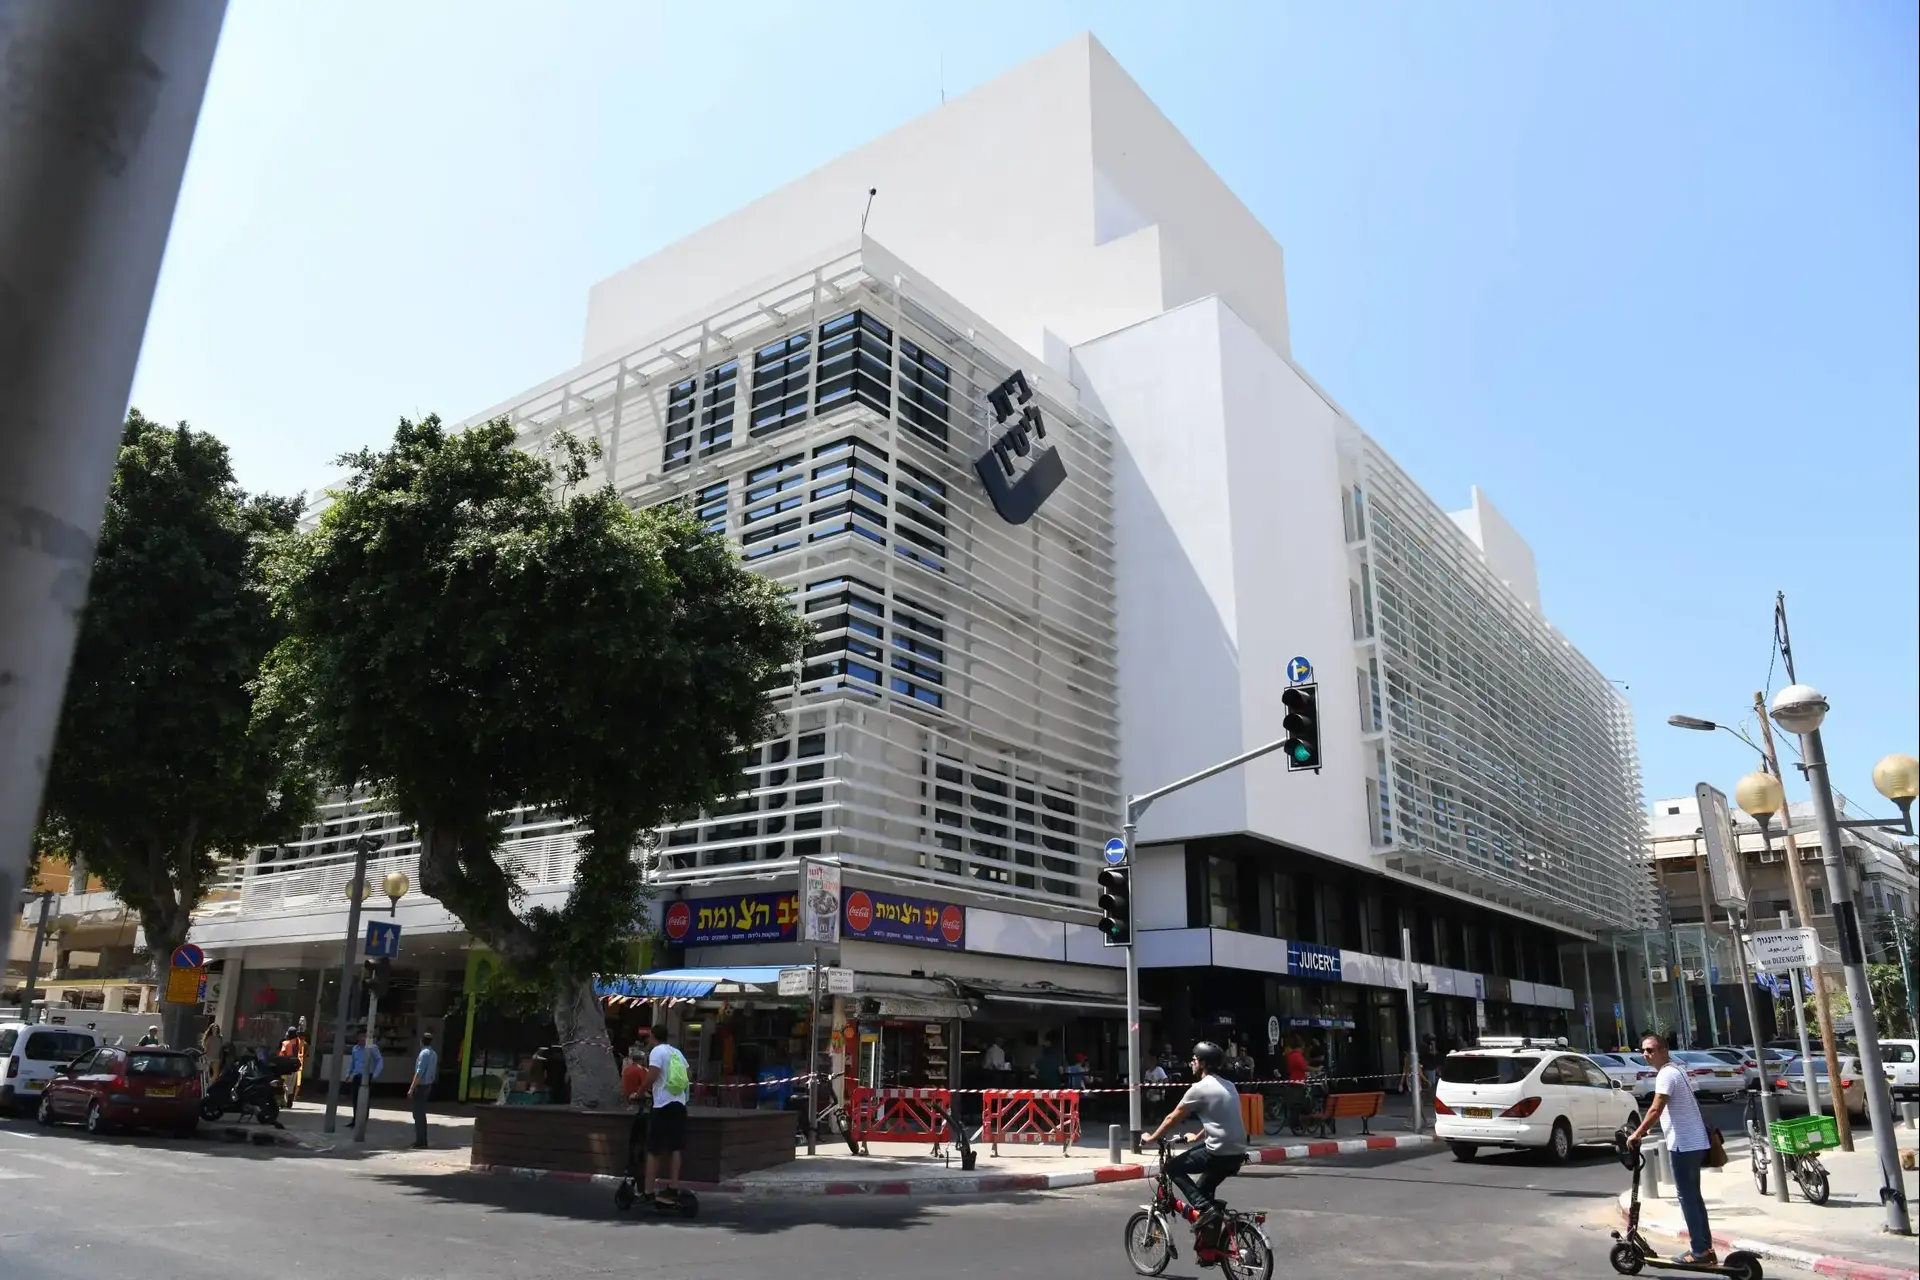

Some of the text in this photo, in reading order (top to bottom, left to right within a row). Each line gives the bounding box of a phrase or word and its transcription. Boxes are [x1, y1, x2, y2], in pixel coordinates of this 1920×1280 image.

[697, 898, 770, 930] הצומת
[875, 902, 939, 925] לב הצומת
[1756, 935, 1782, 946] דיזנגוף
[1299, 950, 1335, 972] JUICERY
[1772, 955, 1806, 965] DIZENGOFF
